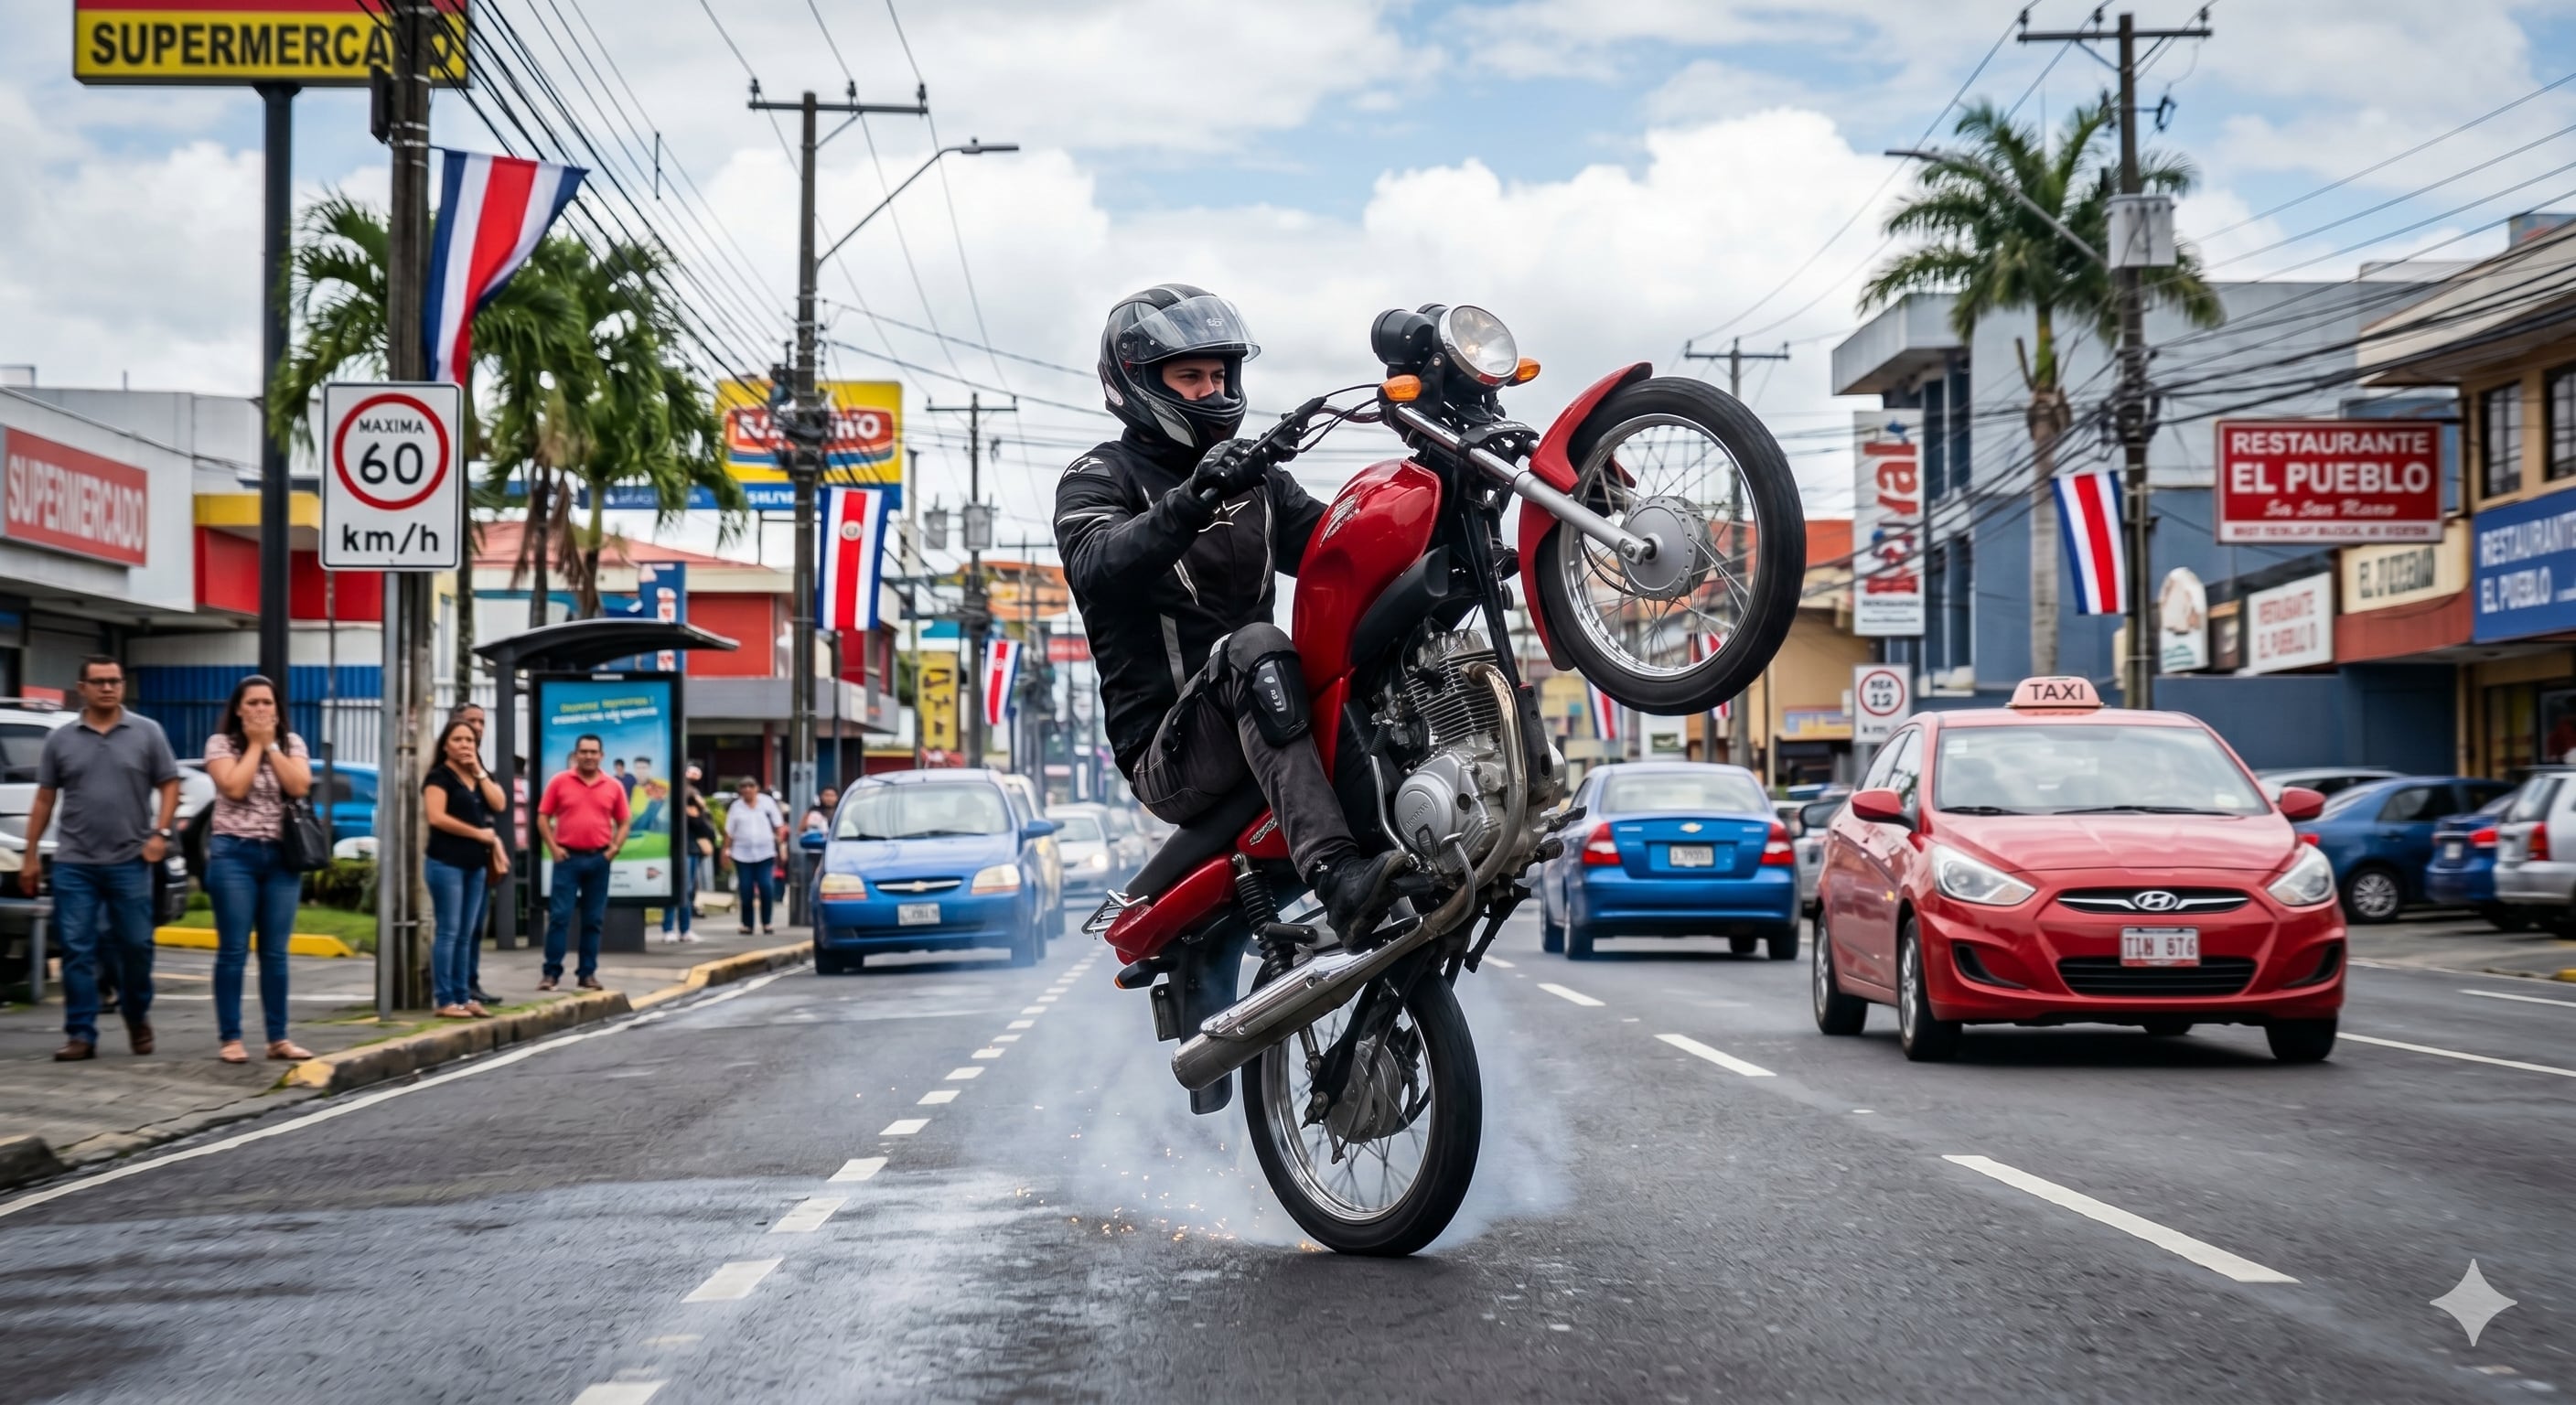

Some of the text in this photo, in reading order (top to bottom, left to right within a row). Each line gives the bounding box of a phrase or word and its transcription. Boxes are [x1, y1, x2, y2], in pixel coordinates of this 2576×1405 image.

[91, 22, 452, 67] SUPERMERCAO
[359, 419, 425, 434] MAXIMA
[2231, 432, 2430, 454] RESTAURANTE
[360, 442, 424, 485] 60
[2231, 462, 2431, 494] EL PUEBLO
[8, 455, 145, 552] SUPERMERCADO
[343, 522, 439, 555] km/h
[2481, 577, 2498, 614] EL
[2499, 566, 2551, 611] PUEBLO
[2028, 683, 2084, 700] TAXI
